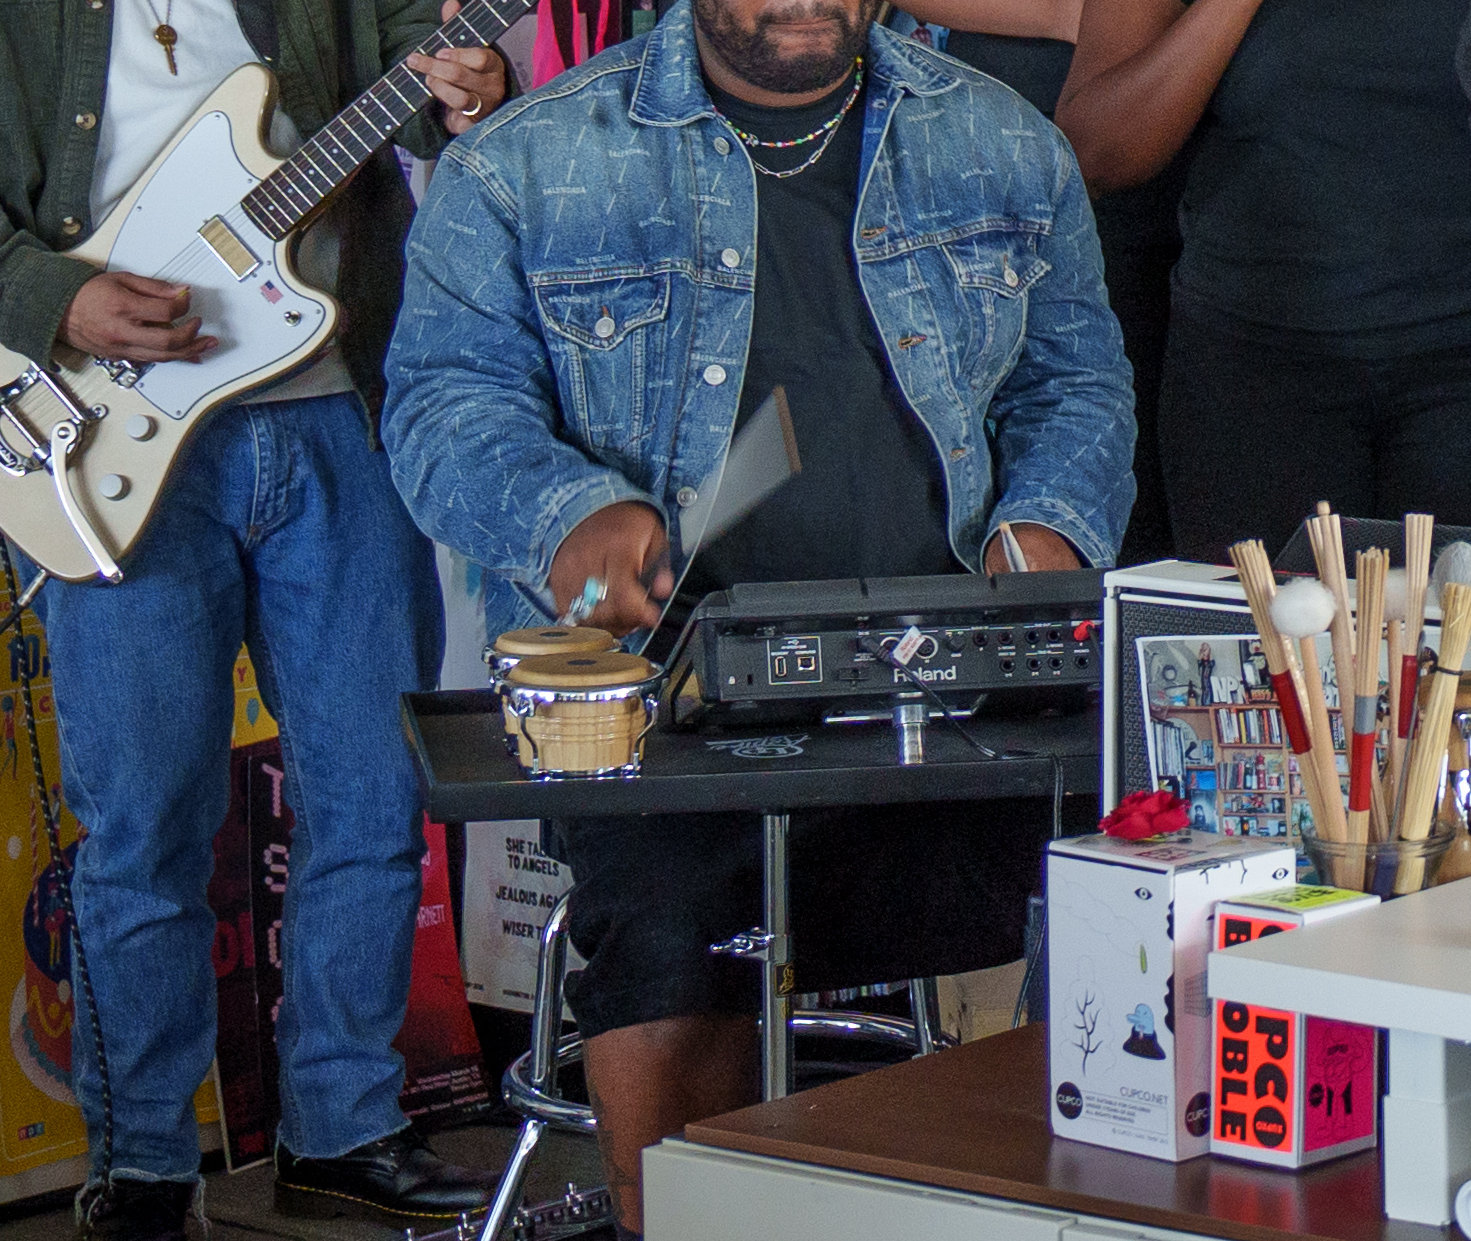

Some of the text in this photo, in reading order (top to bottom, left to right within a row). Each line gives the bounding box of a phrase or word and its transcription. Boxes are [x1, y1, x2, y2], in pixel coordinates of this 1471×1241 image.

[506, 837, 525, 855] SHE
[508, 854, 560, 877] TO ANGELS
[495, 885, 538, 908] JEALOUS
[502, 919, 534, 938] WISER
[1057, 1094, 1082, 1107] CUPCO
[1119, 1086, 1169, 1105] CUPCO.NET
[1186, 1108, 1210, 1122] CUPC
